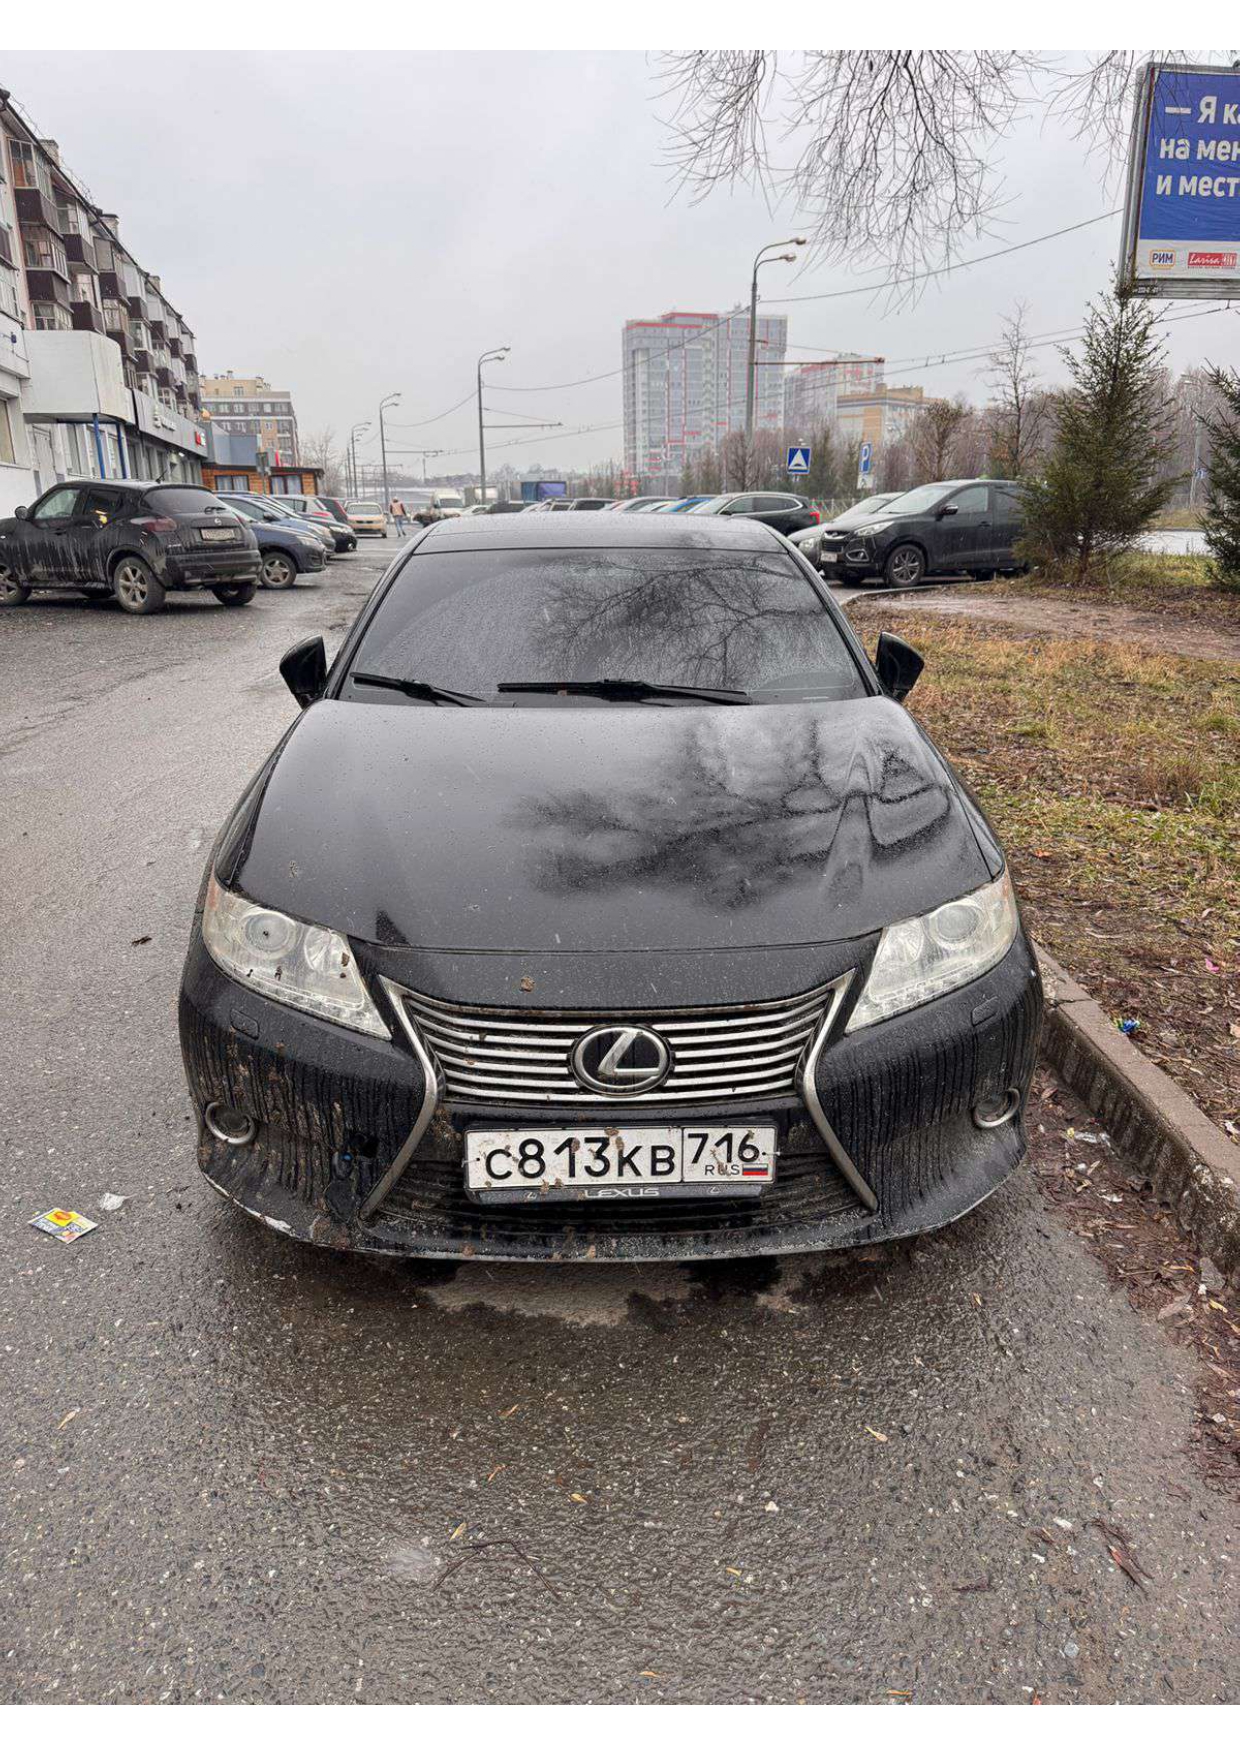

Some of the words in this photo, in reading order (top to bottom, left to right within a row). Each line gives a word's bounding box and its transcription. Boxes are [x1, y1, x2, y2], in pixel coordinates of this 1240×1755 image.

[1198, 95, 1217, 124] Я
[1223, 103, 1240, 124] к
[1160, 138, 1190, 160] на
[1156, 174, 1172, 195] и
[1152, 252, 1174, 264] РИМ
[687, 1131, 760, 1164] 716
[704, 1164, 740, 1176] RUS
[584, 1188, 660, 1198] LEXUS
